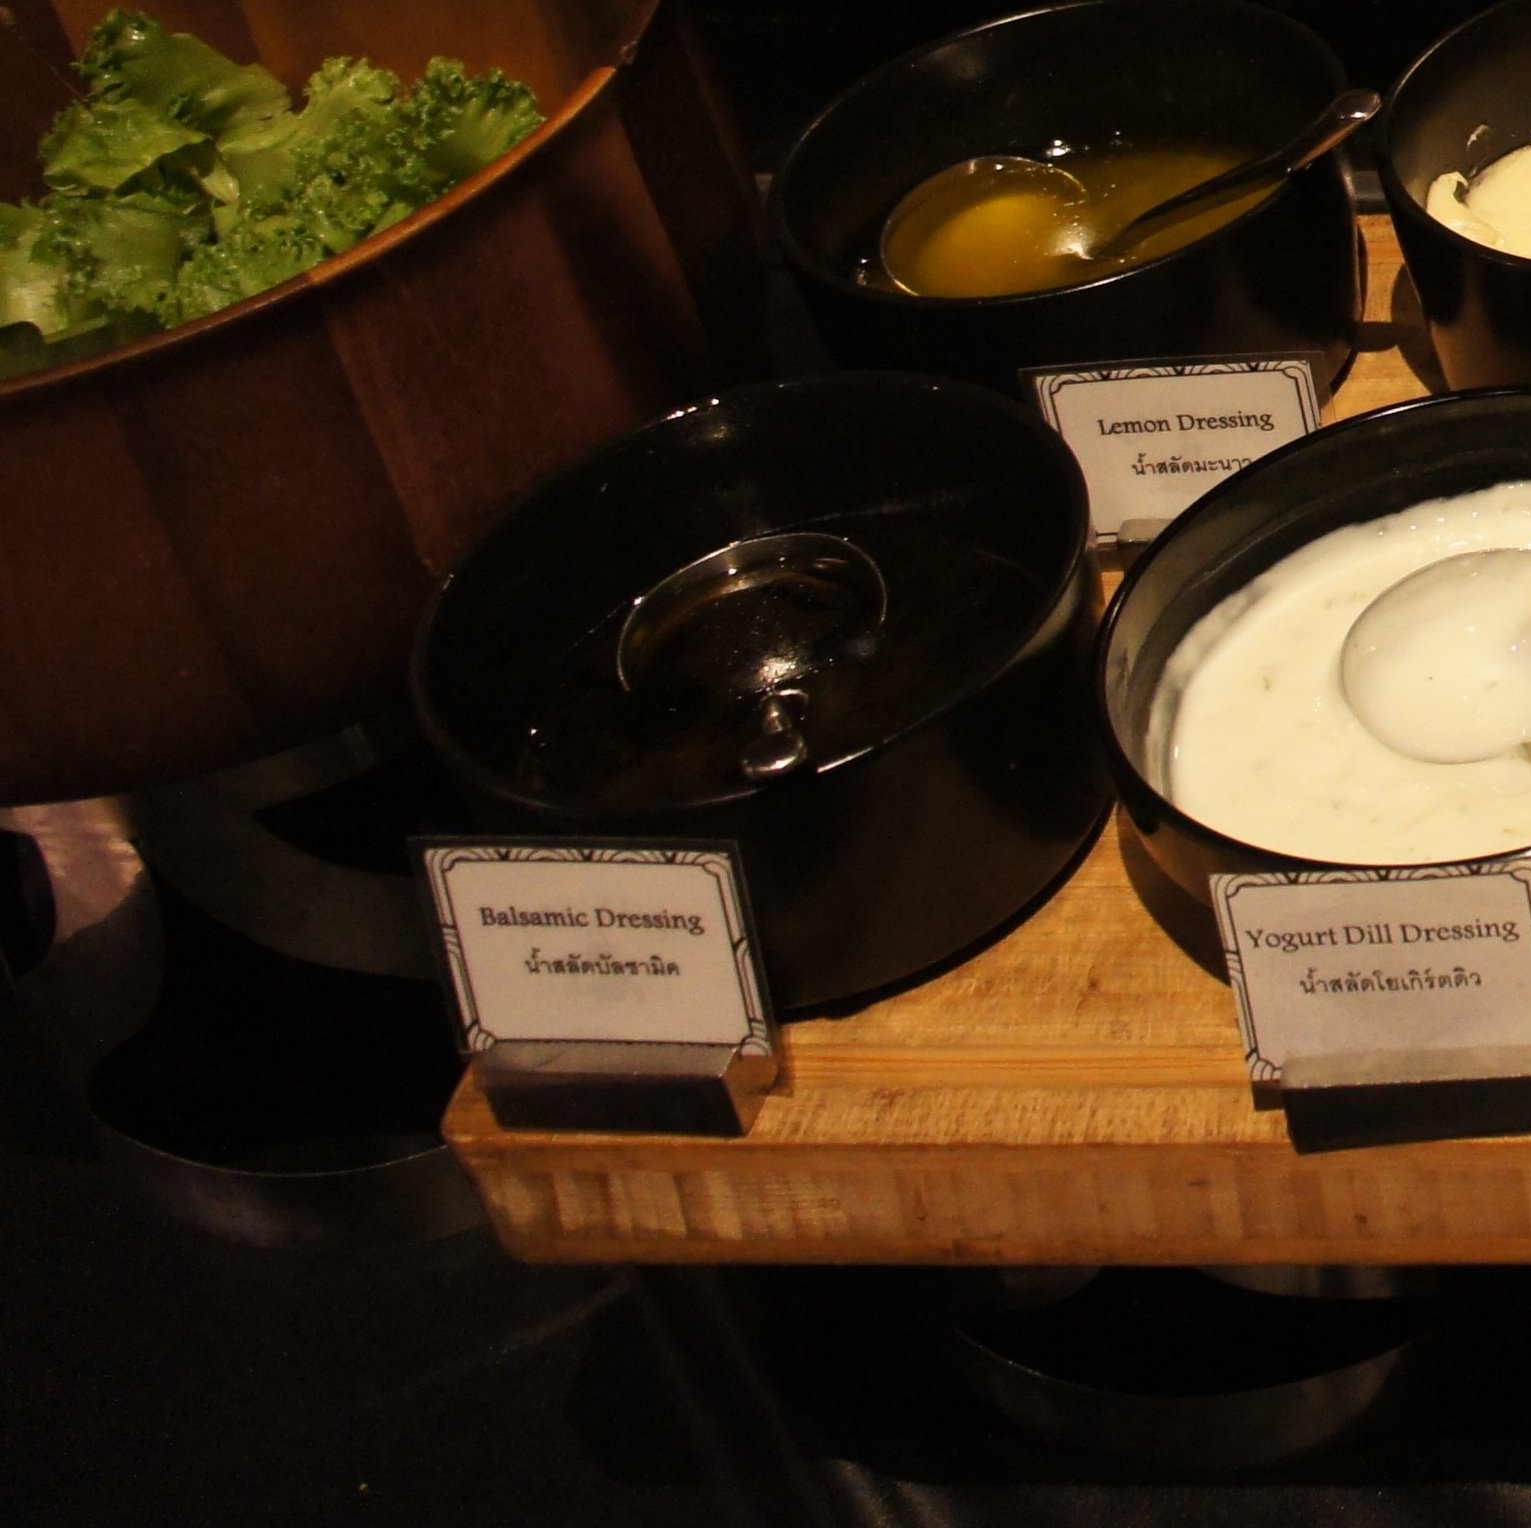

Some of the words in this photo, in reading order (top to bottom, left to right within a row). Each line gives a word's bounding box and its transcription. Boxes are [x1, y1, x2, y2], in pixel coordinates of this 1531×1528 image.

[1097, 419, 1171, 435] Lemon
[1176, 411, 1274, 431] Dressing
[479, 906, 590, 928] Balsamic
[595, 909, 704, 935] Dressing
[1246, 929, 1337, 953] Yogurt
[1343, 923, 1393, 946] Dill
[1401, 919, 1520, 942] Dressing
